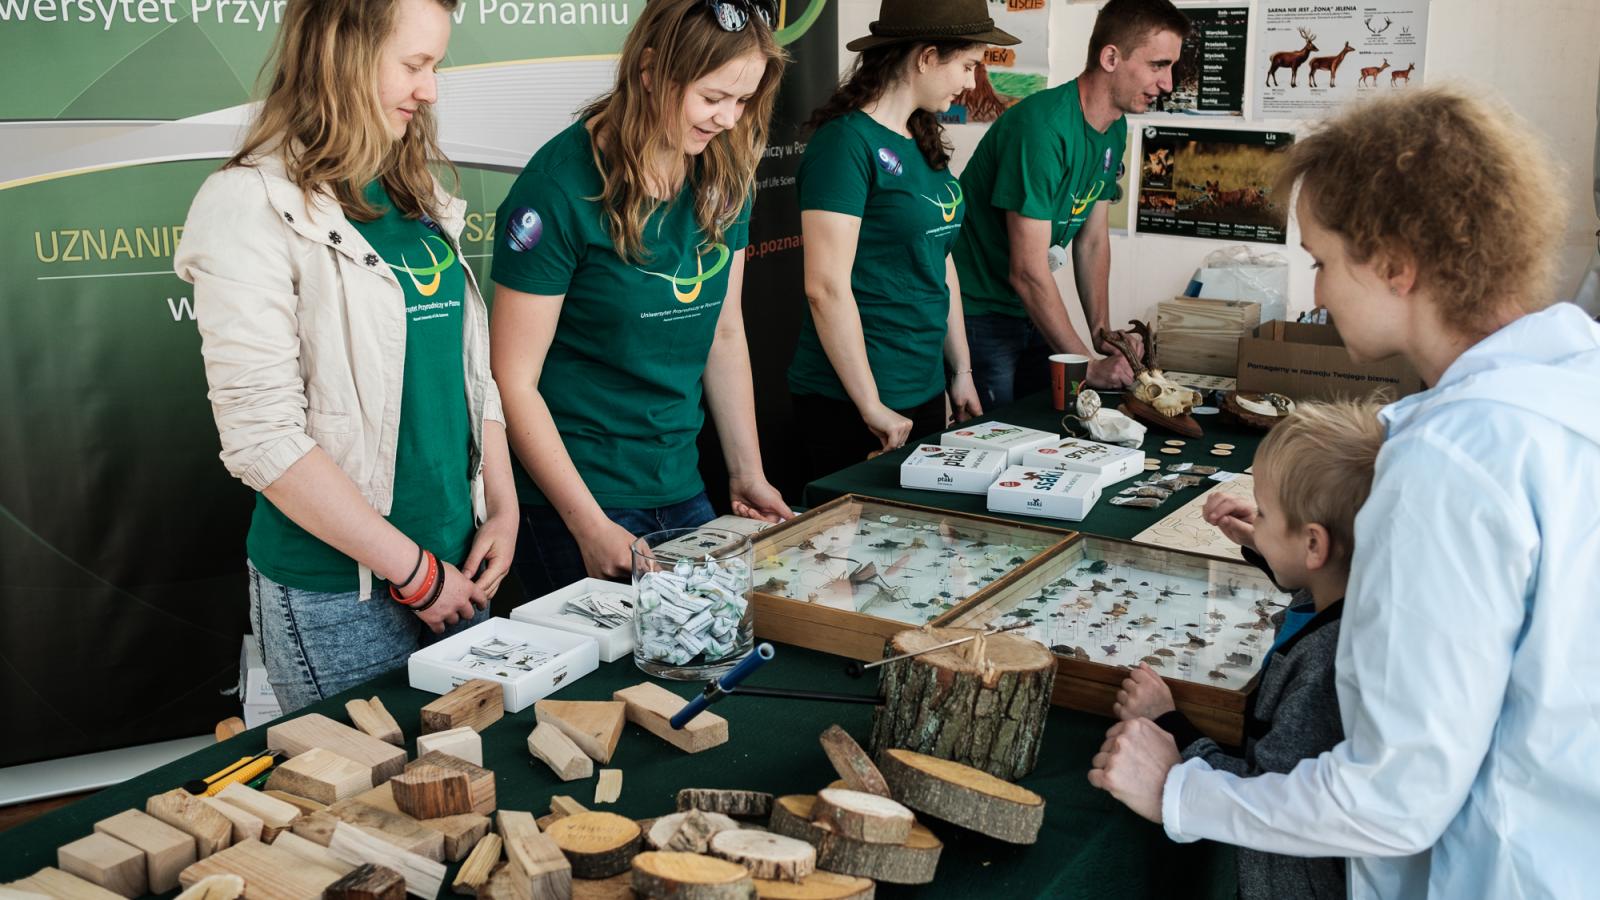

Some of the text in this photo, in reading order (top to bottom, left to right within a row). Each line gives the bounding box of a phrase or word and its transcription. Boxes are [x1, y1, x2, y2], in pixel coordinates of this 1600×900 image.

[479, 0, 629, 25] Poznaniu
[785, 145, 792, 155] w
[1247, 362, 1289, 374] Pomagamy
[1300, 369, 1331, 377] rozwoju
[1333, 371, 1366, 381] Twojego
[1367, 374, 1400, 384] biznesu
[937, 474, 954, 483] ptaki
[1033, 470, 1065, 491] ssaki
[1027, 500, 1042, 508] ssaki
